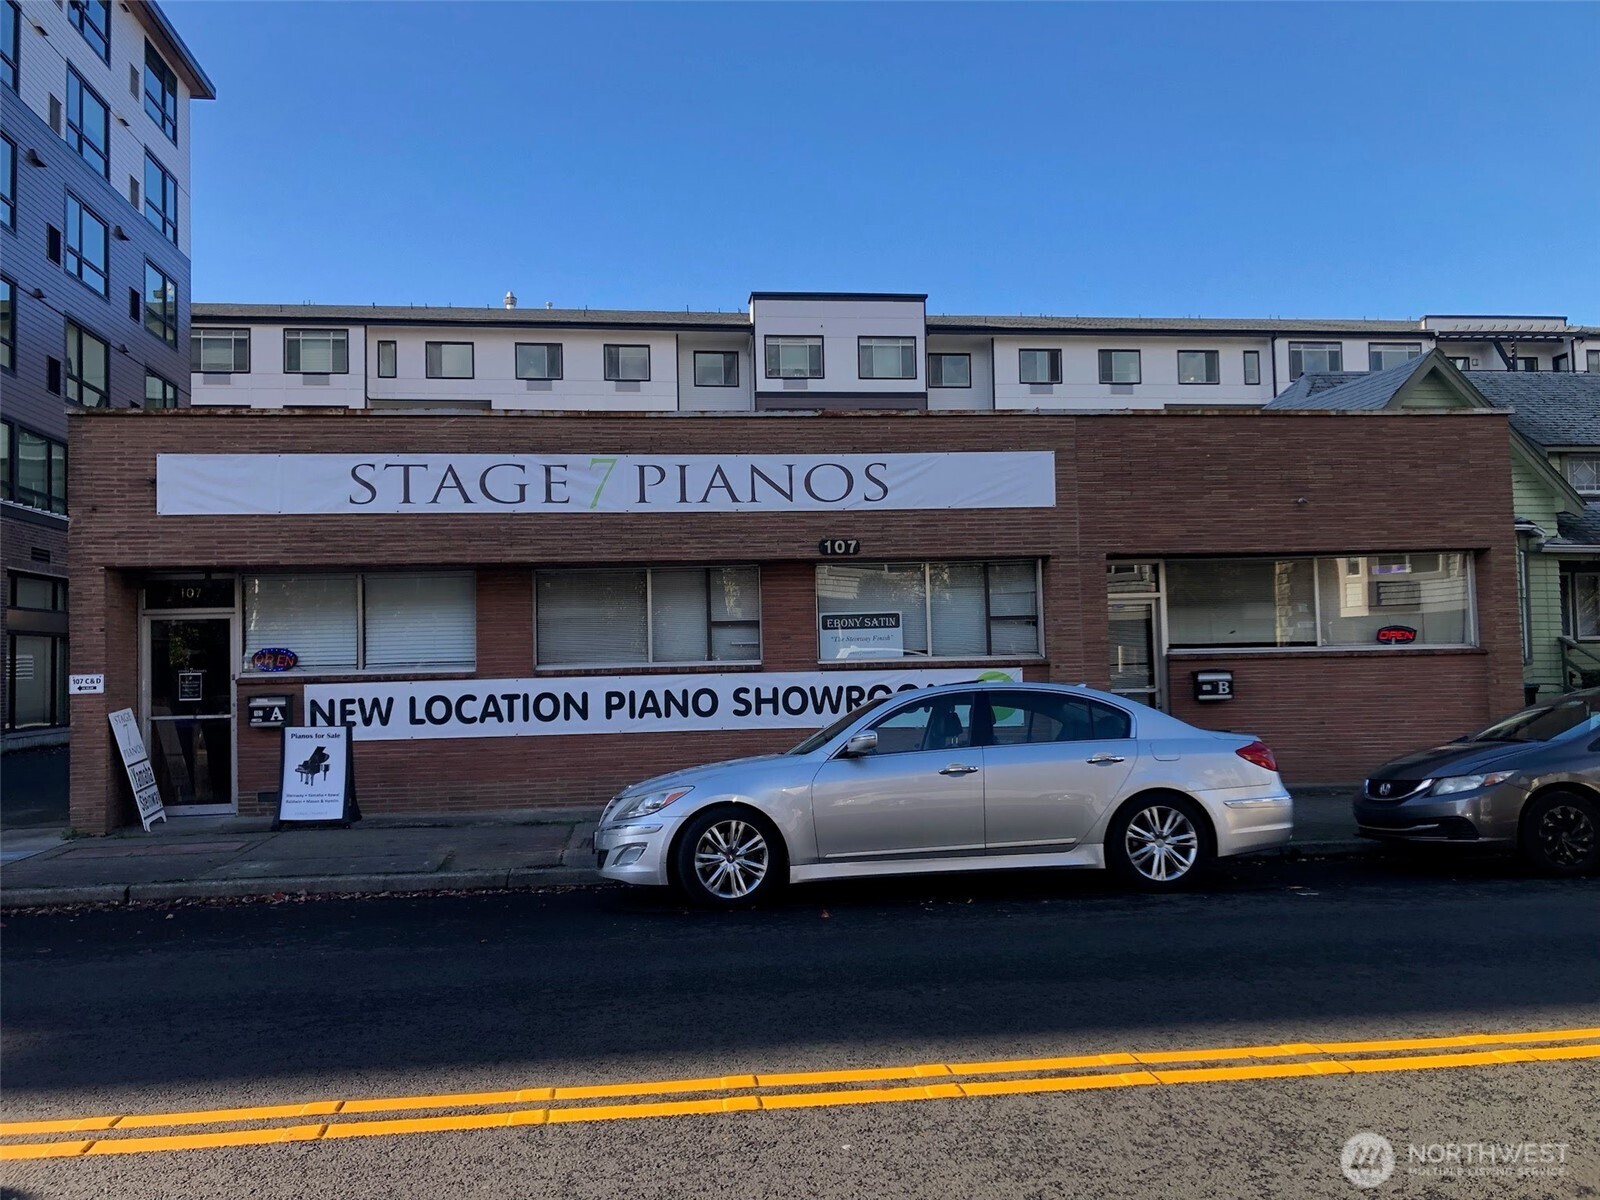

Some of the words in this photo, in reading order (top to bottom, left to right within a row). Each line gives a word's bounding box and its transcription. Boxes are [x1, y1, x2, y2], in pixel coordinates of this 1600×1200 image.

[349, 463, 570, 504] STAGE
[588, 458, 618, 510] 7
[633, 462, 889, 504] PIANOS
[824, 540, 857, 554] 107
[181, 587, 202, 599] 107
[827, 617, 862, 628] EBONY
[864, 616, 896, 627] SATIN
[1378, 630, 1414, 640] OPEN
[254, 653, 295, 668] OPEN
[1218, 681, 1230, 694] B
[270, 706, 284, 721] A
[310, 696, 394, 727] NEW
[409, 691, 589, 725] LOCATION
[605, 687, 719, 720] PIANO
